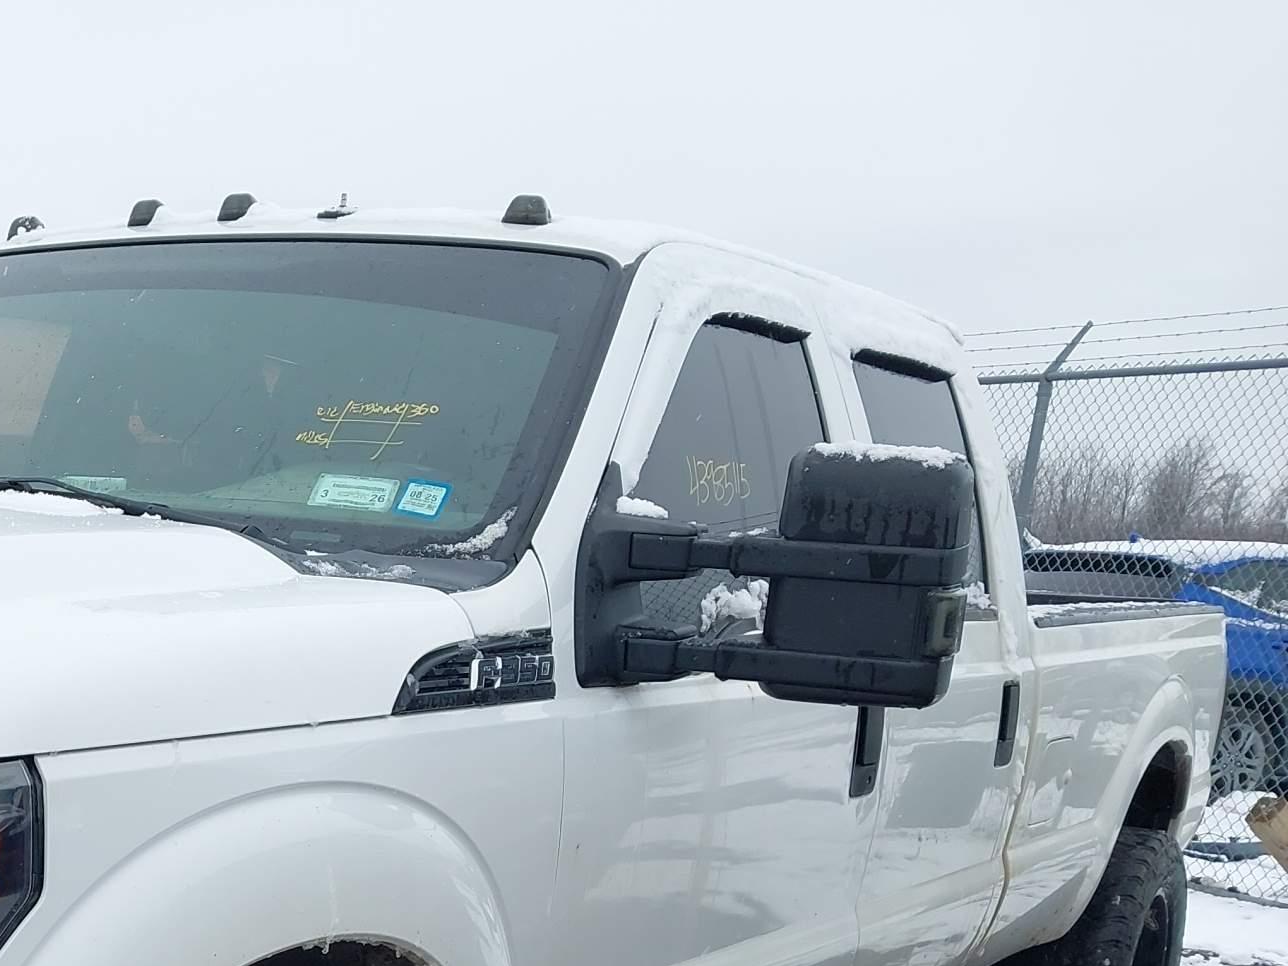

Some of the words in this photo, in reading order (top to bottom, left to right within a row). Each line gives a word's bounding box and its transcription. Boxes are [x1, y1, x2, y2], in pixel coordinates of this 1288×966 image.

[686, 455, 751, 507] 43985115
[368, 493, 386, 504] 26
[424, 492, 439, 503] 25
